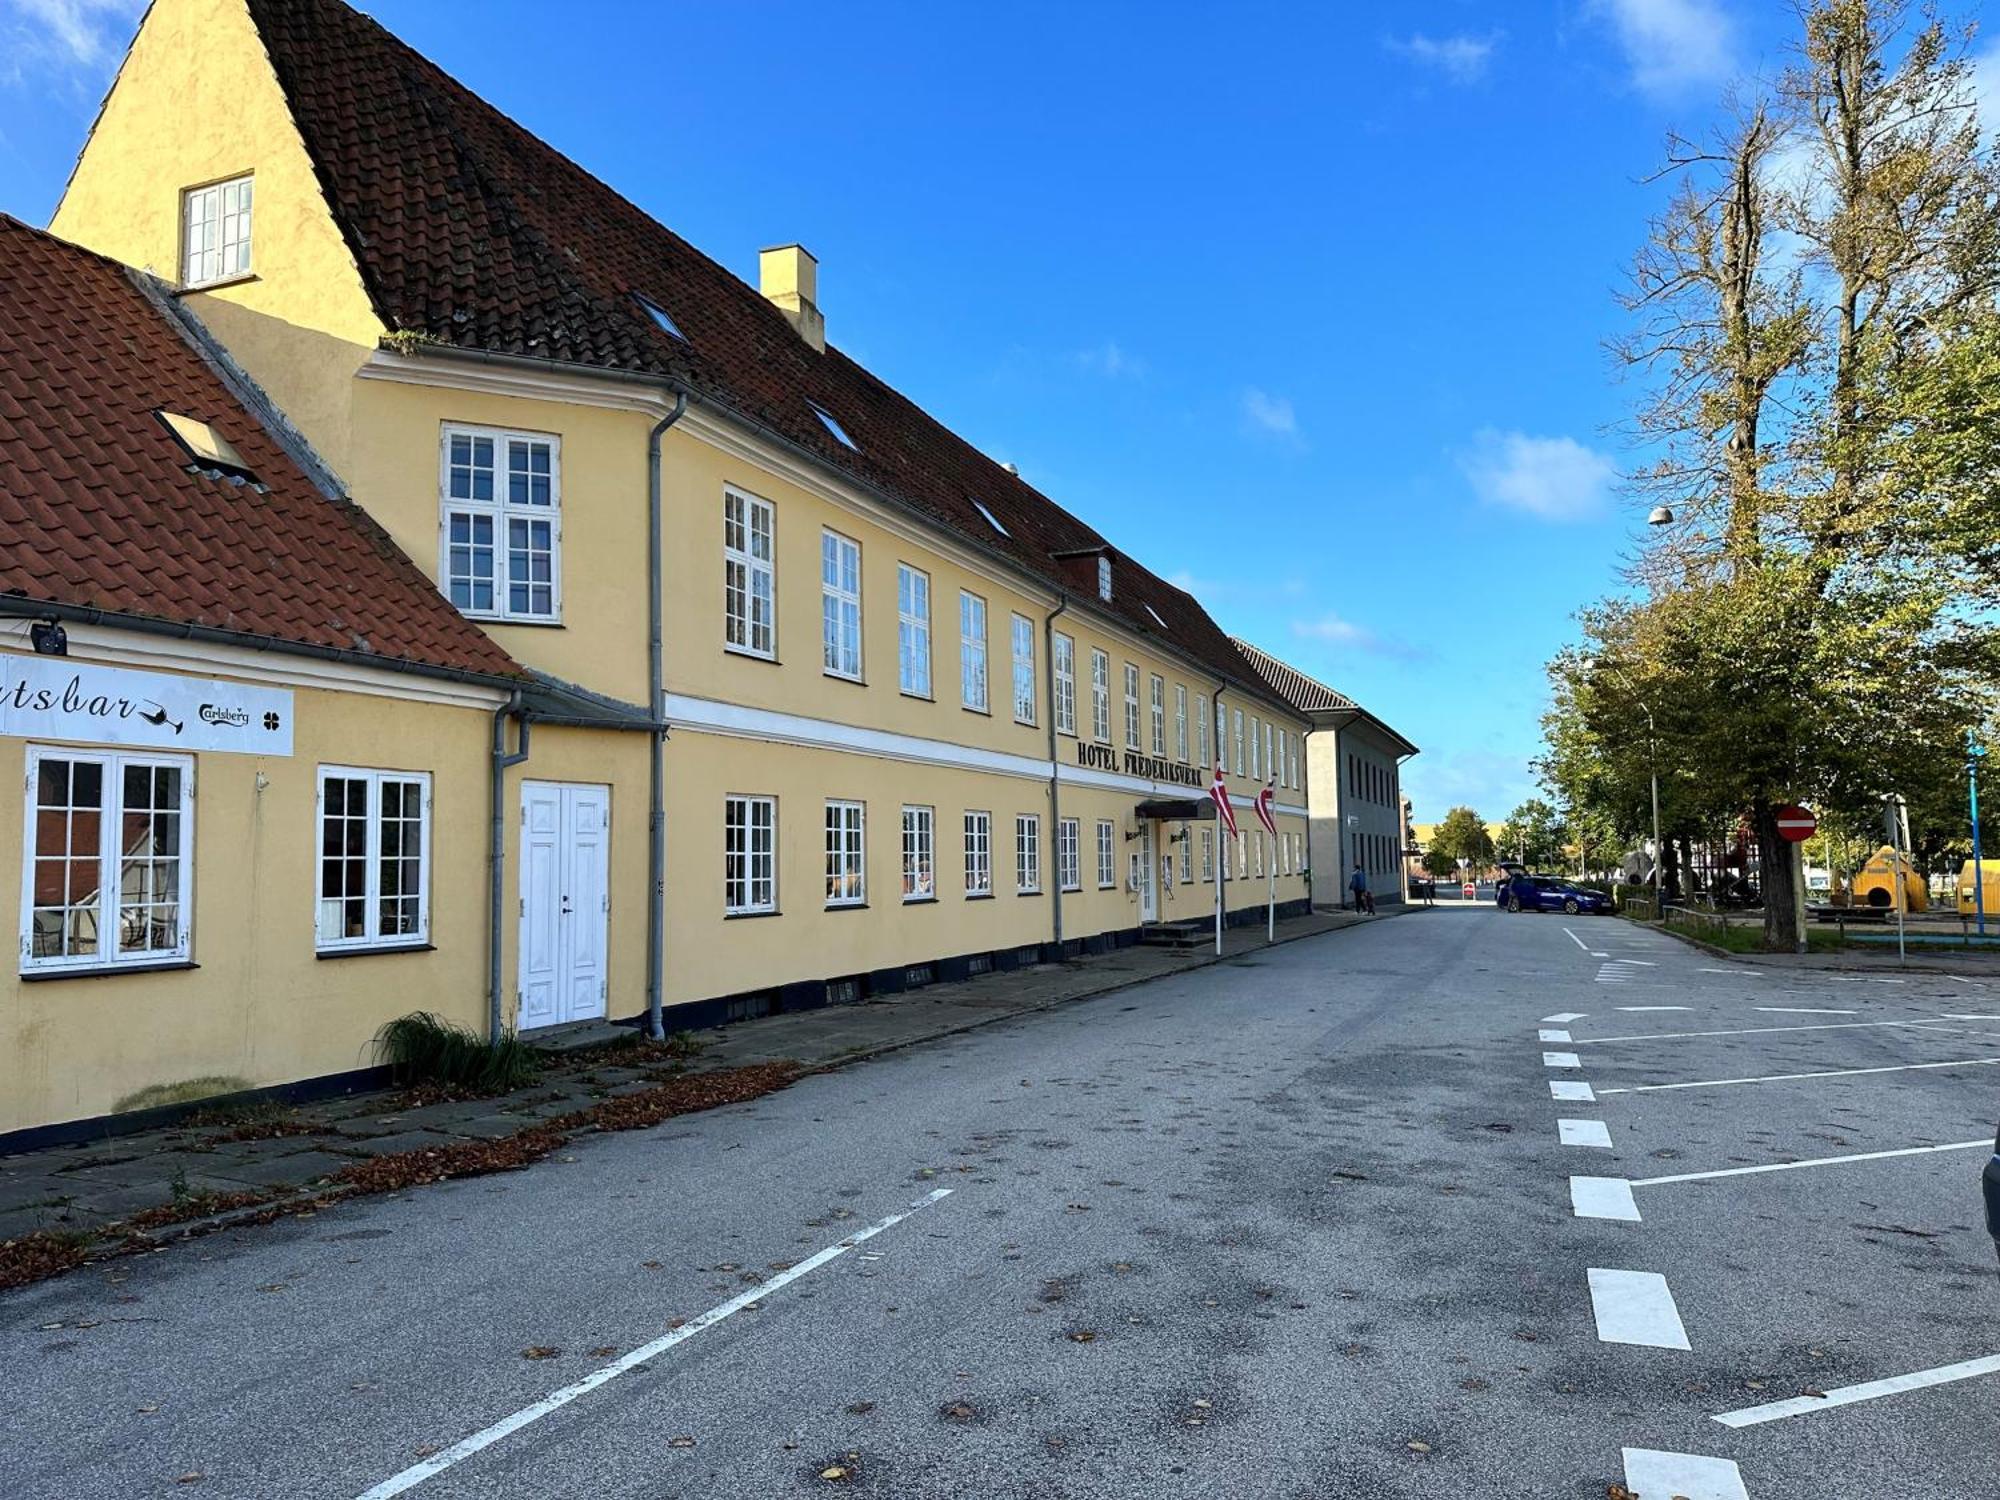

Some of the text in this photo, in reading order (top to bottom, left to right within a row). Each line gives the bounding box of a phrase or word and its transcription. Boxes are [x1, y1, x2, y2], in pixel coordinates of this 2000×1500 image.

[199, 704, 248, 727] Carlsberg
[1078, 742, 1202, 786] HOTEL FREDERIKSVÆRK
